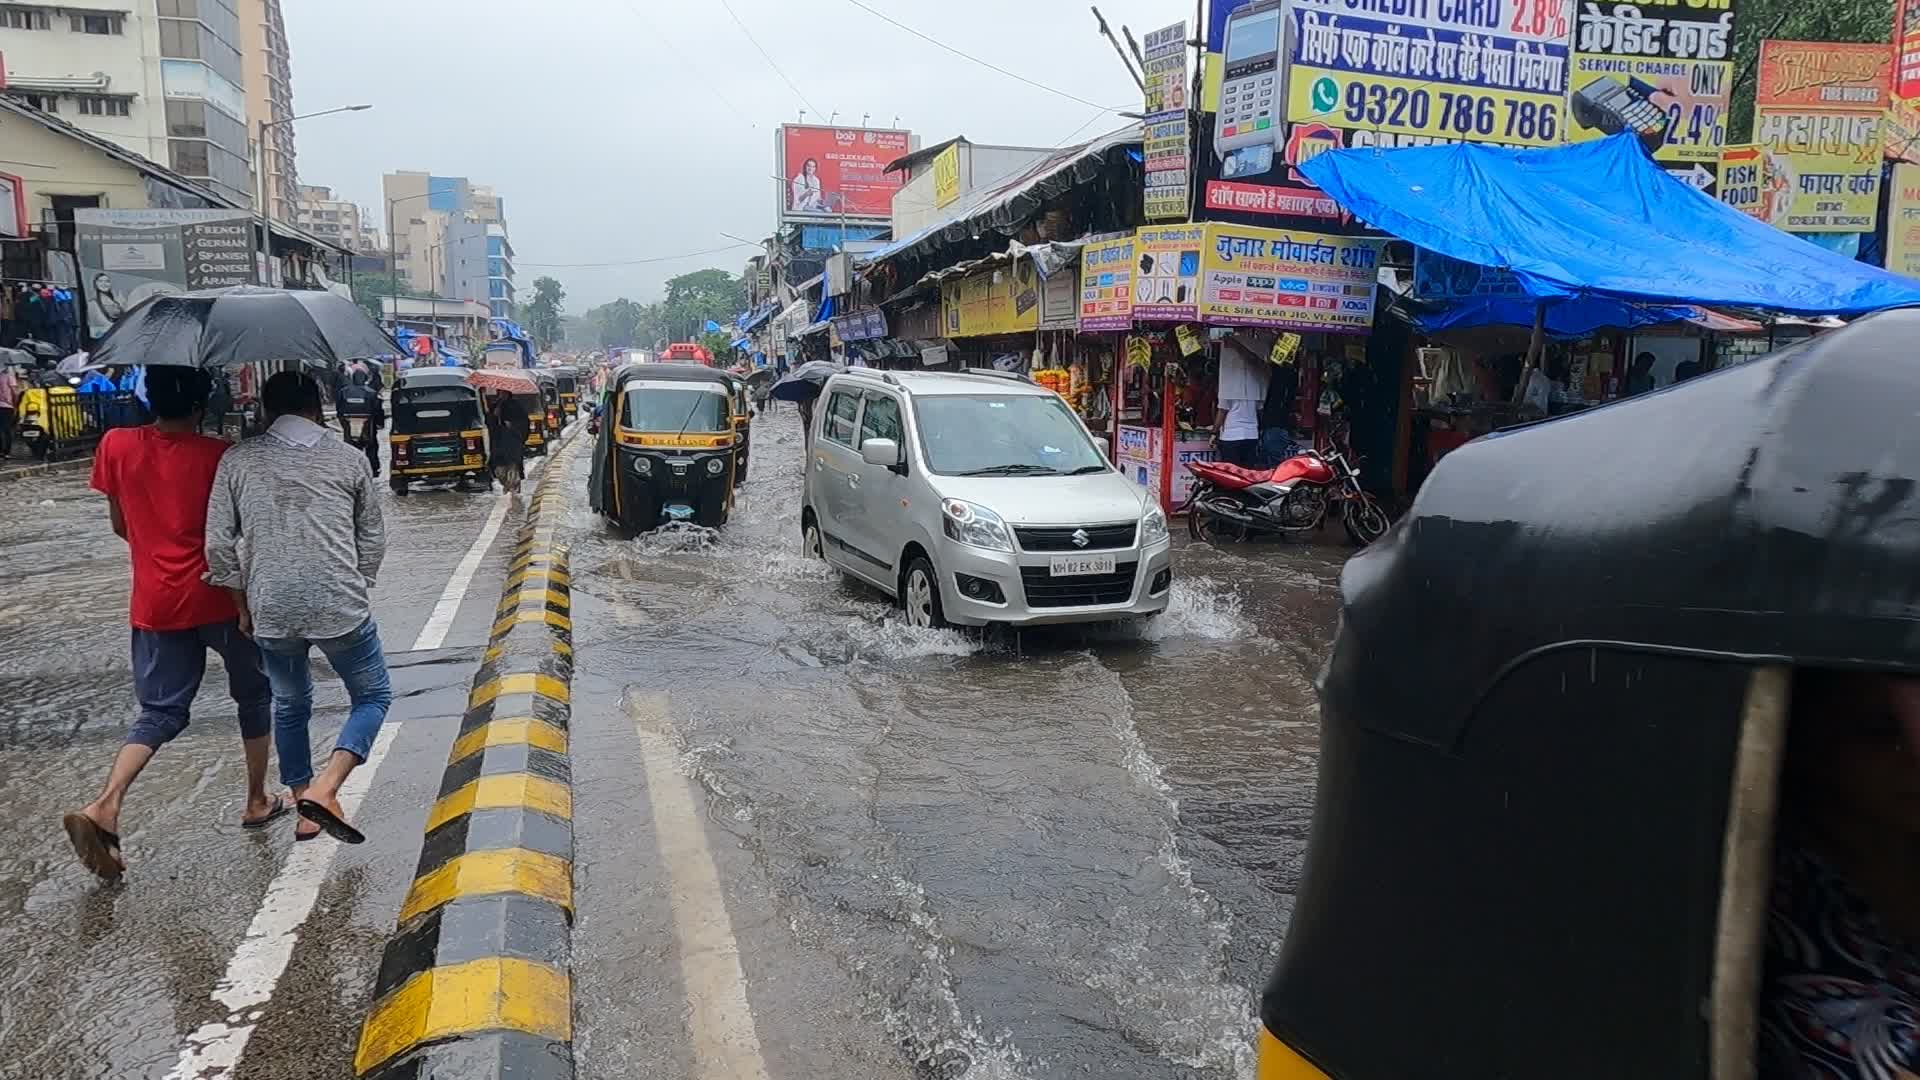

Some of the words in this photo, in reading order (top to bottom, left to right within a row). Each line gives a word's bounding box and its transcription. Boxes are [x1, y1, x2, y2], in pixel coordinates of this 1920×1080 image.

[1578, 2, 1665, 54] क्रेडिट
[1667, 11, 1734, 59] कार्ड
[1300, 10, 1341, 65] सिर्फ
[1341, 28, 1372, 68] एक
[1371, 23, 1409, 74] कॉल
[1512, 40, 1565, 92] मिलेगा
[1578, 58, 1632, 73] SERVICE
[1636, 61, 1687, 75] CHARGE
[1691, 63, 1726, 95] ONLY
[1344, 81, 1430, 129] 9320
[1439, 92, 1496, 135] 786
[1504, 99, 1557, 141] 786
[1666, 103, 1723, 147] 2.4%
[1726, 165, 1757, 184] FISH
[1721, 187, 1758, 205] FOOD
[195, 226, 246, 235] FRENCH
[197, 239, 247, 249] GERMAN
[1216, 234, 1266, 261] जुजार
[1341, 244, 1377, 268] शॉप
[199, 252, 249, 261] SPANISH
[200, 264, 251, 273] CHINESE
[1214, 273, 1242, 285] Apple
[1281, 281, 1306, 291] vivo
[1209, 305, 1230, 313] ALL
[1234, 307, 1253, 315] SIM
[1053, 562, 1066, 573] MH
[1080, 561, 1094, 572] EK
